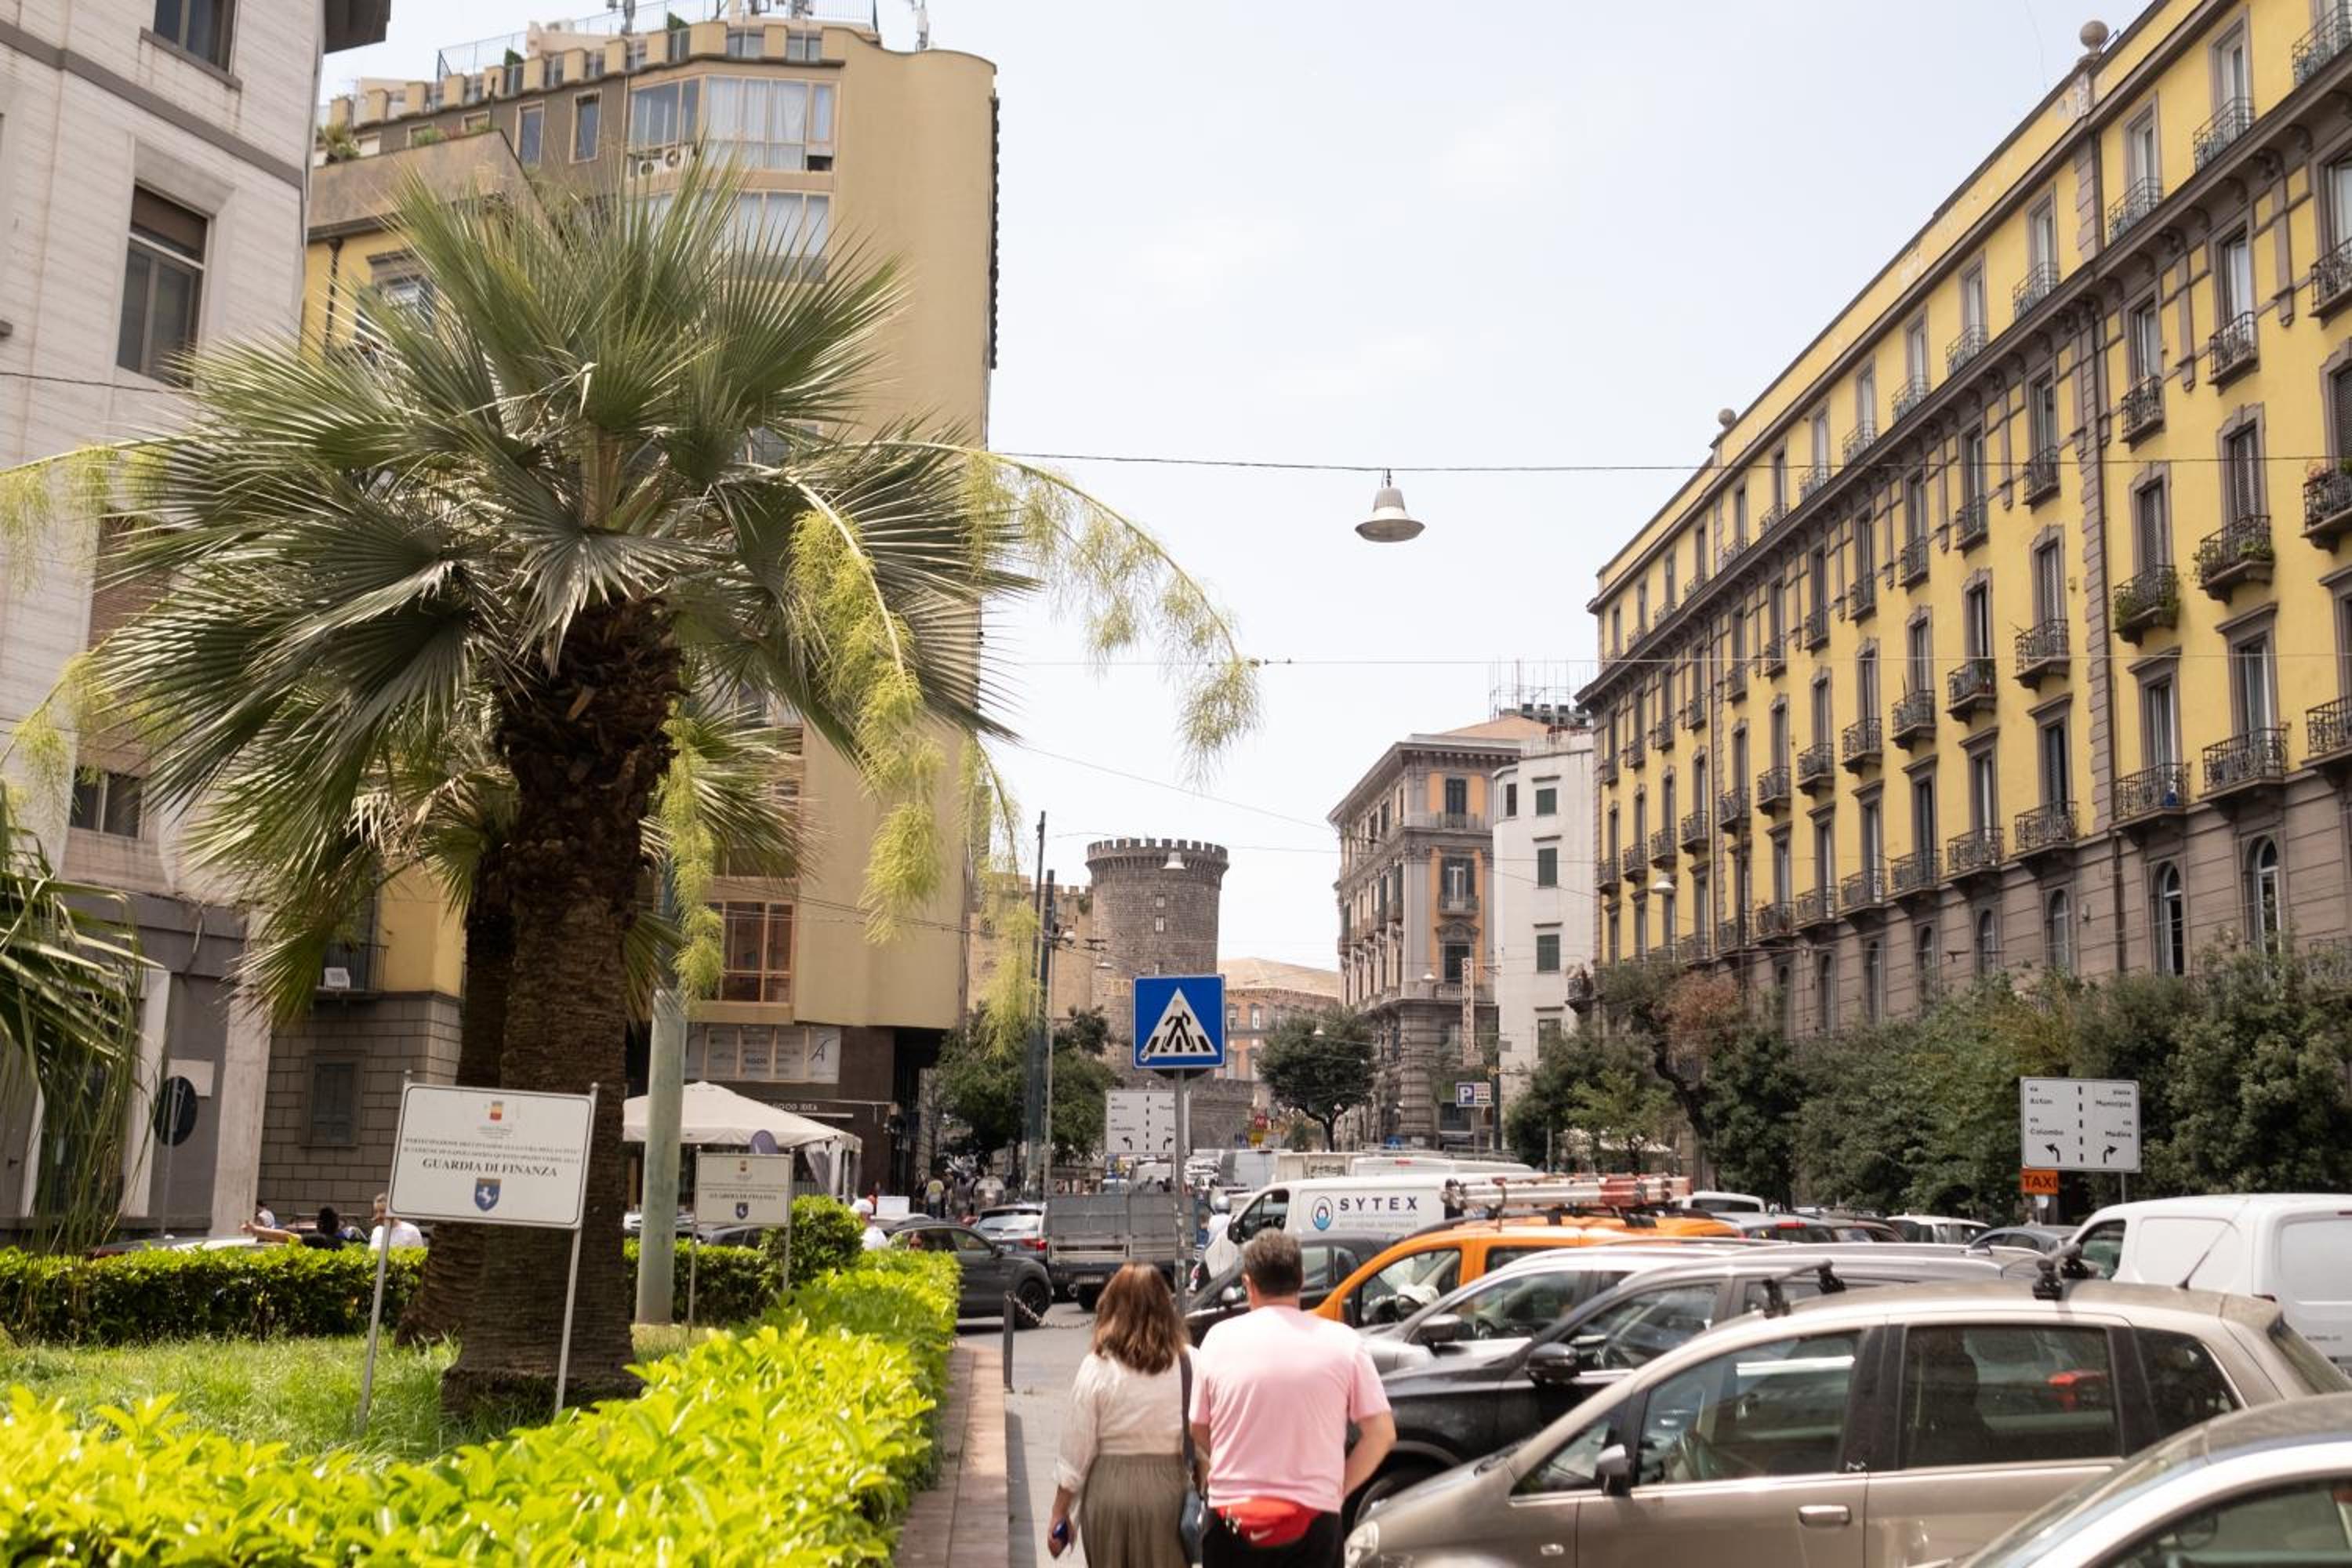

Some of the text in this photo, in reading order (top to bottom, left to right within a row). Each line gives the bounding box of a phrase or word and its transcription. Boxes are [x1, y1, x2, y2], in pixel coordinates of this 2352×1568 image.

[1459, 1086, 1472, 1103] P
[2096, 1099, 2132, 1108] Municipio
[2030, 1127, 2064, 1136] Colombo
[423, 1158, 558, 1178] GUARDIA DI FINANZA
[2024, 1174, 2057, 1188] TAXI
[1340, 1197, 1417, 1210] SYTEX
